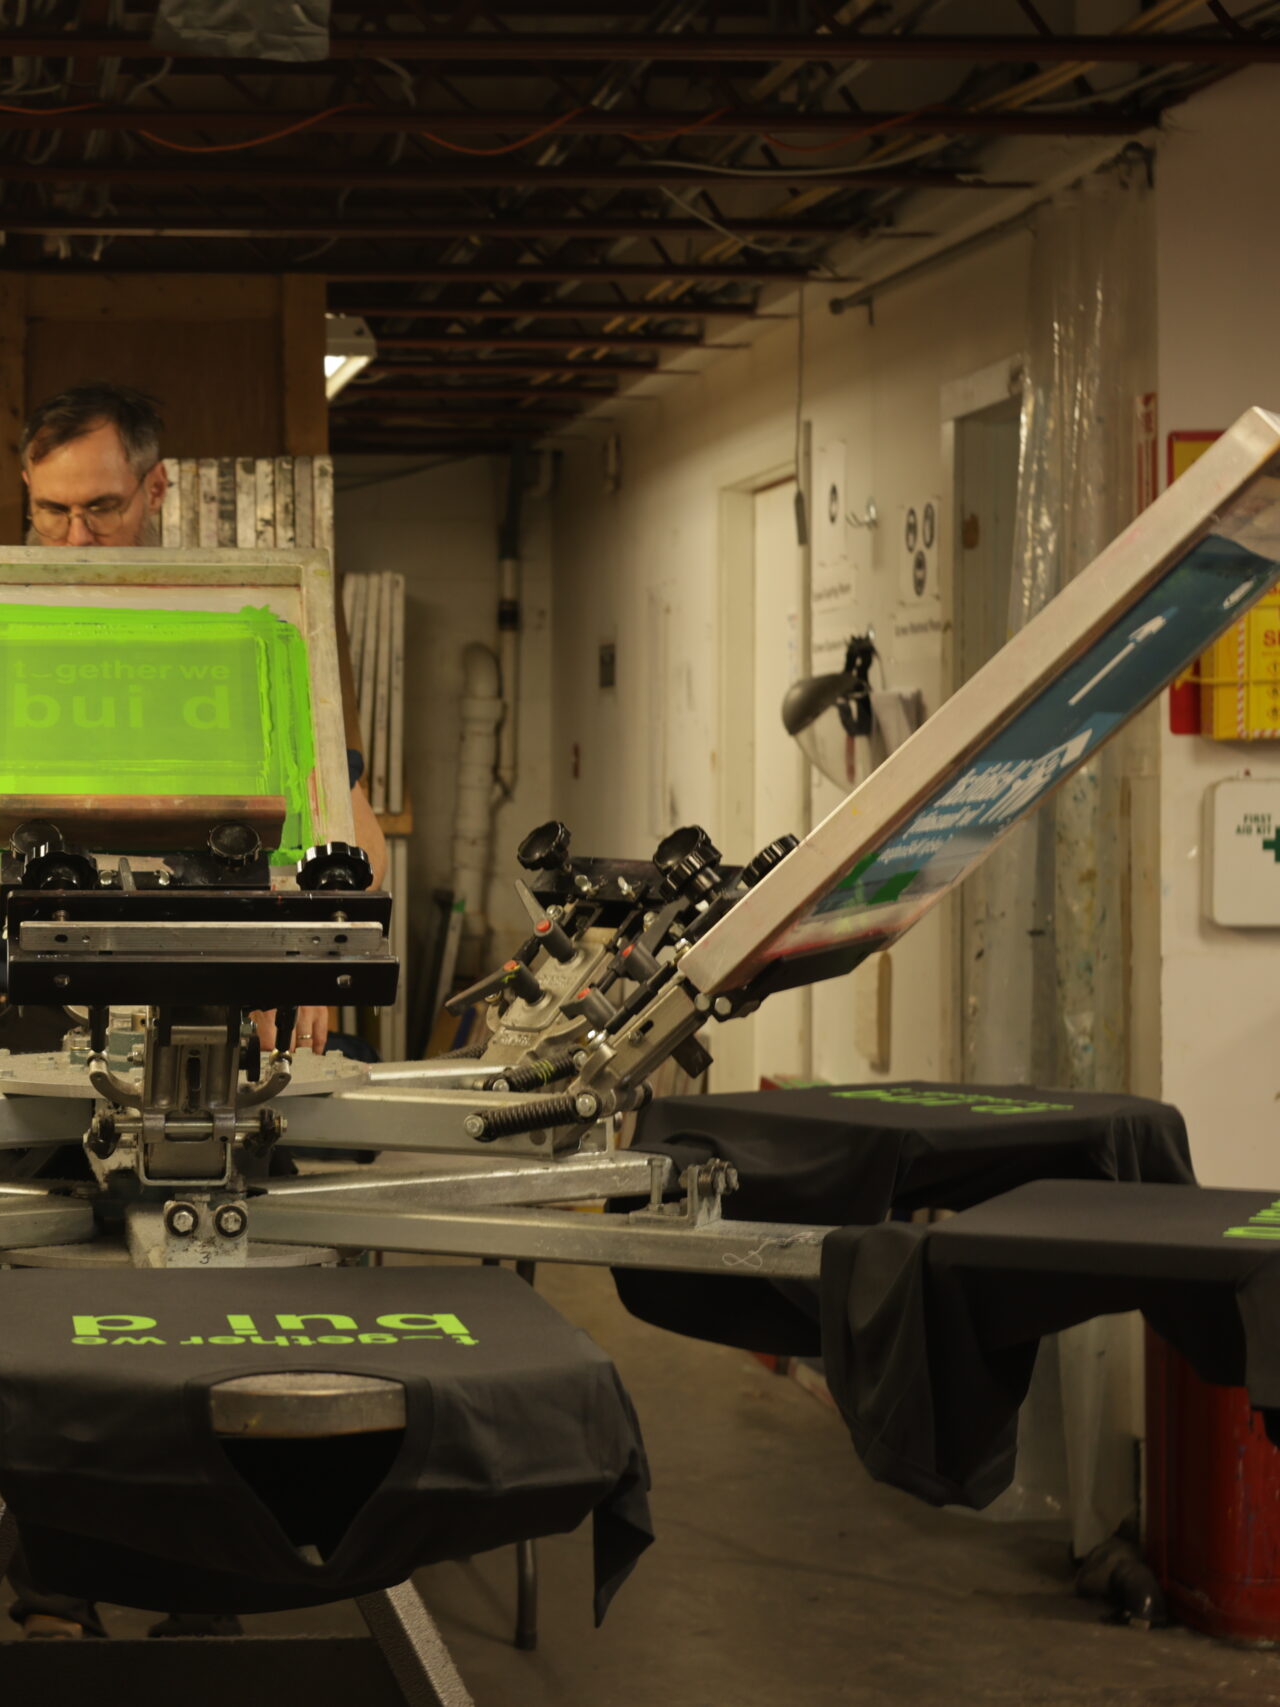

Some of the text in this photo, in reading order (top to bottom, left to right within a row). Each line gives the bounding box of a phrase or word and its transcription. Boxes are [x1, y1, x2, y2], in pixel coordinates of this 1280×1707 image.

[180, 663, 231, 680] we
[1243, 813, 1272, 824] FIRST
[1235, 825, 1272, 835] AID KIT
[70, 1336, 168, 1346] we
